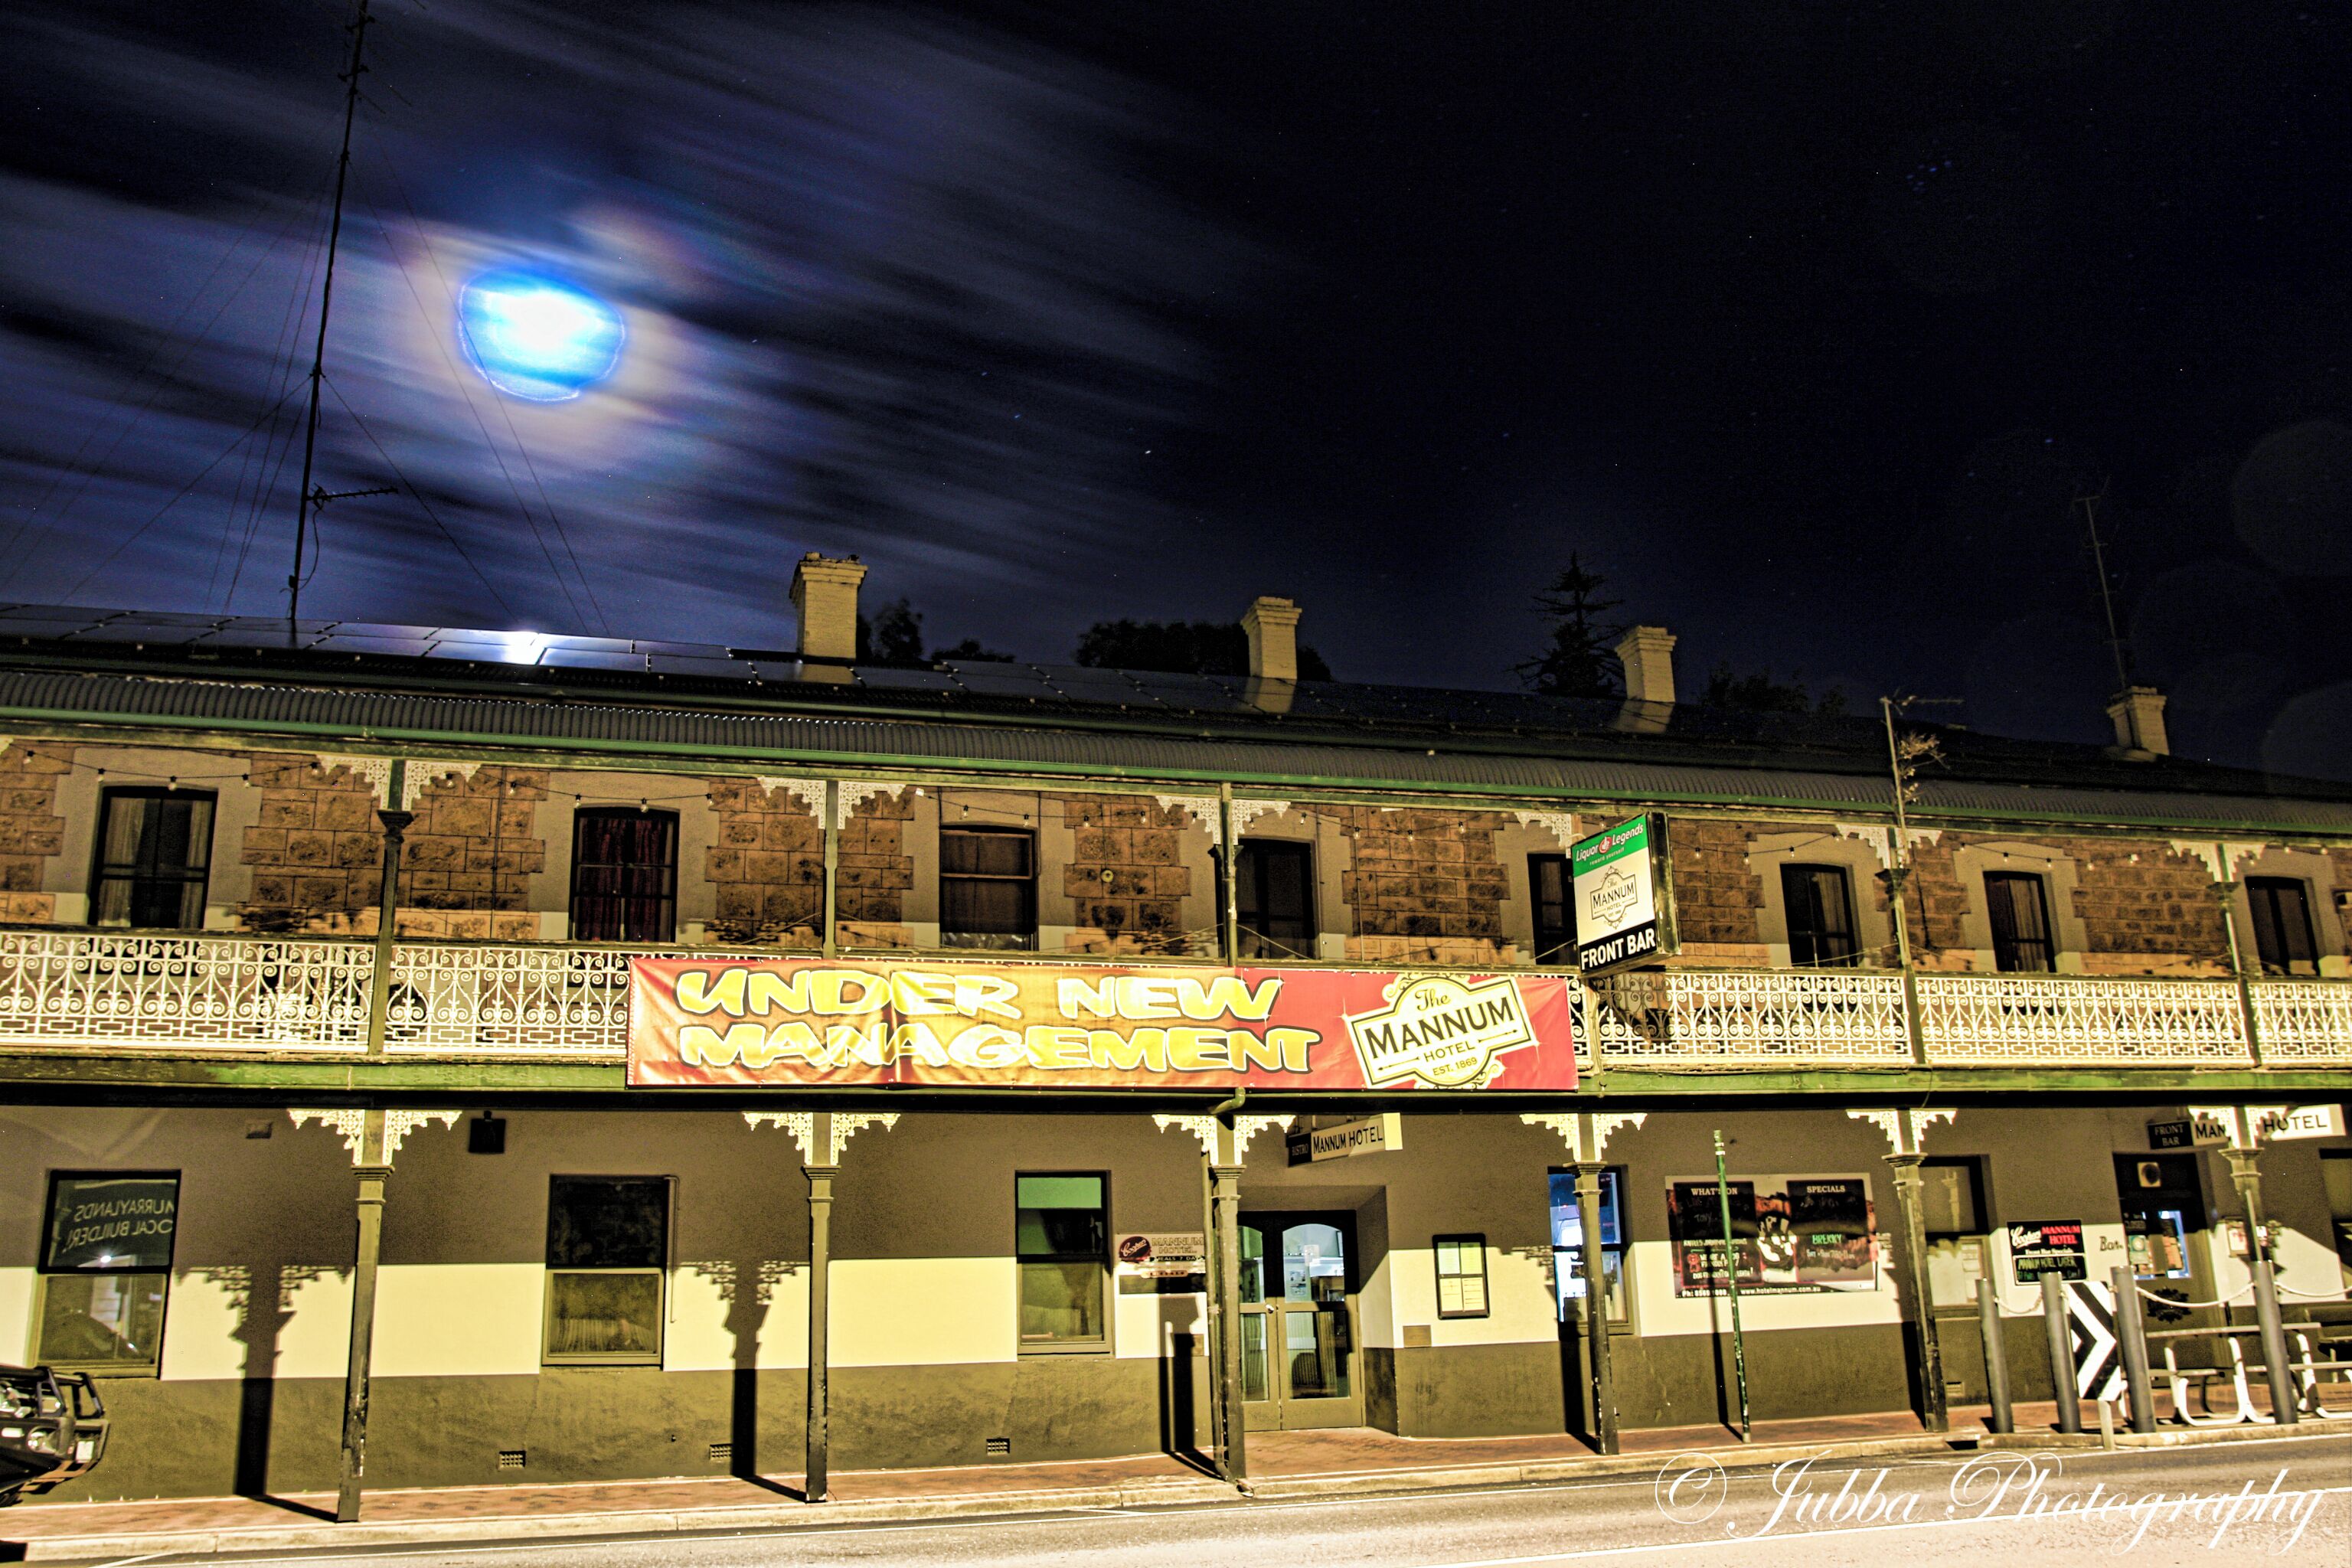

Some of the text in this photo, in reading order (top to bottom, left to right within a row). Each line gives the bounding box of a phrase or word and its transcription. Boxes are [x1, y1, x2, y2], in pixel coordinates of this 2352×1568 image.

[1576, 823, 1644, 861] Liquor Legends
[1592, 881, 1635, 910] MANNUM
[1606, 902, 1622, 911] HOTEL
[1580, 928, 1655, 971] FRONT BAR
[675, 968, 1284, 1021] UNDER NEW
[1414, 988, 1452, 1011] The
[1364, 996, 1515, 1060] MANNUM
[678, 1021, 1321, 1073] MANAGEMENT
[1423, 1039, 1476, 1063] HOTEL
[1432, 1057, 1478, 1076] EST. 1869
[2154, 1123, 2184, 1136] FRONT
[2262, 1114, 2328, 1133] HOTEL
[1313, 1125, 1383, 1155] MANNUM HOTEL
[2161, 1136, 2180, 1147] BAR
[1806, 1185, 1846, 1194] SPECIALS
[2040, 1225, 2082, 1234] MANNUM
[1152, 1236, 1204, 1247] MANNUM
[2049, 1234, 2078, 1245] HOTEL
[1158, 1246, 1197, 1255] HOTEL
